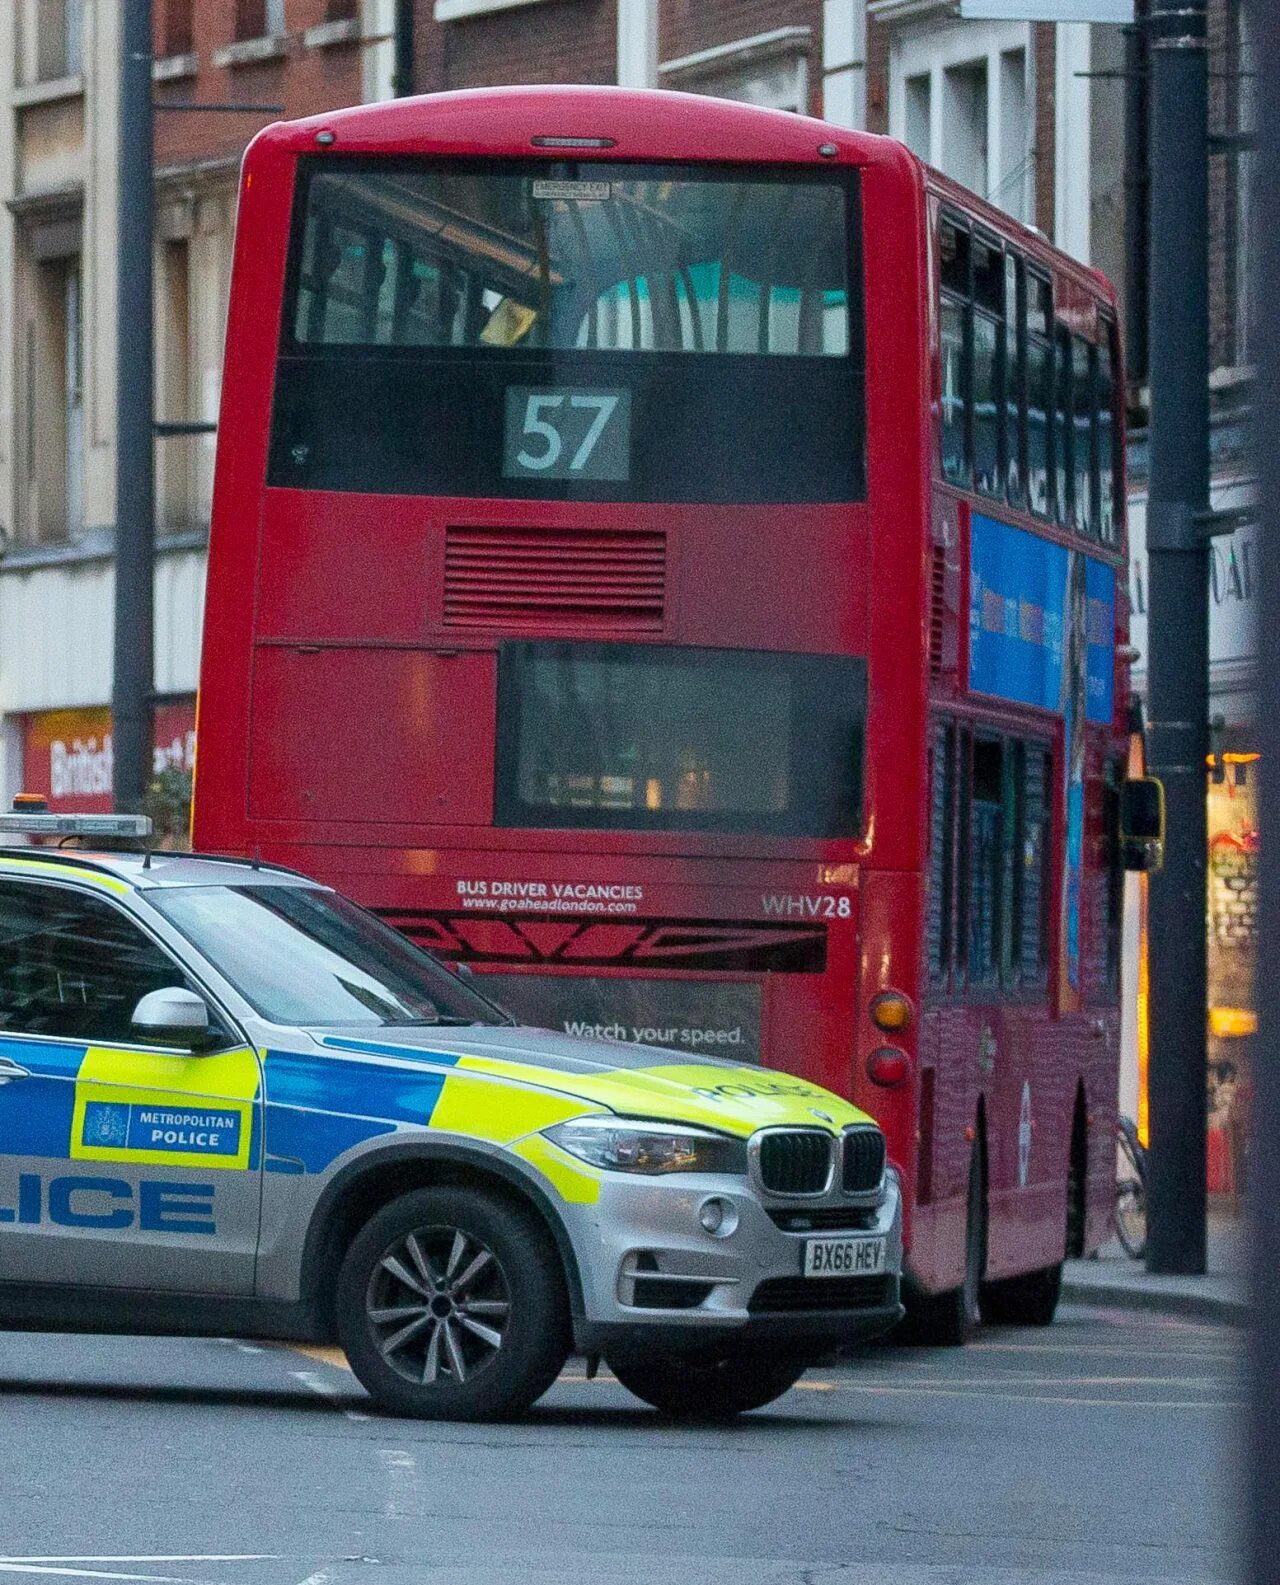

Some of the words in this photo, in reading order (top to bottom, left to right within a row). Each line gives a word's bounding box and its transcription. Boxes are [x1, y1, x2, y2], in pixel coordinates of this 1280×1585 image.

[516, 394, 620, 471] 57
[456, 880, 487, 895] BUS
[491, 882, 548, 897] DRIVER
[552, 884, 644, 899] VACANCIES
[462, 898, 637, 912] www.goaheadlondon.com
[761, 895, 851, 918] WHV28
[563, 1021, 627, 1040] Watch
[632, 1026, 678, 1043] your
[680, 1026, 746, 1046] speed.
[140, 1112, 234, 1128] METROPOLITAN
[151, 1129, 220, 1146] POLICE
[812, 1242, 853, 1272] BX66
